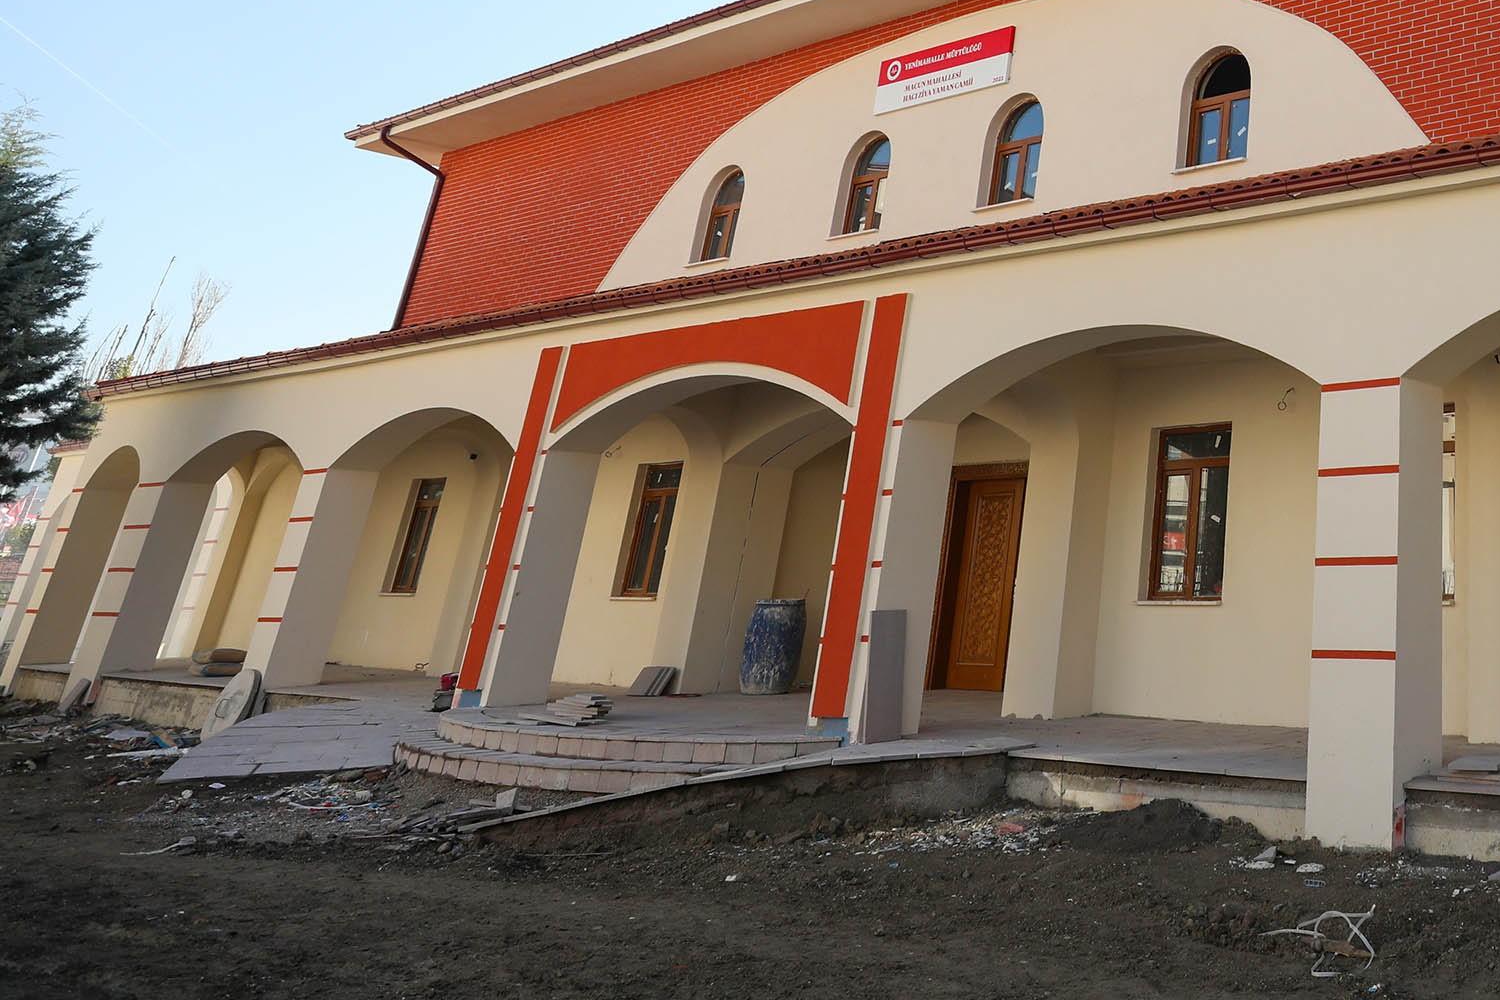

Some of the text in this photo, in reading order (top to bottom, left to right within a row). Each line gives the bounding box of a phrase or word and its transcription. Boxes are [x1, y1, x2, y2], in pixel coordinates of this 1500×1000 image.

[905, 42, 982, 70] YENİMAHALLE MÜFTÜLÜĞÜ
[902, 93, 918, 103] HACI
[932, 81, 955, 95] YAMAN
[904, 70, 961, 92] MACUN MAHALLESİ
